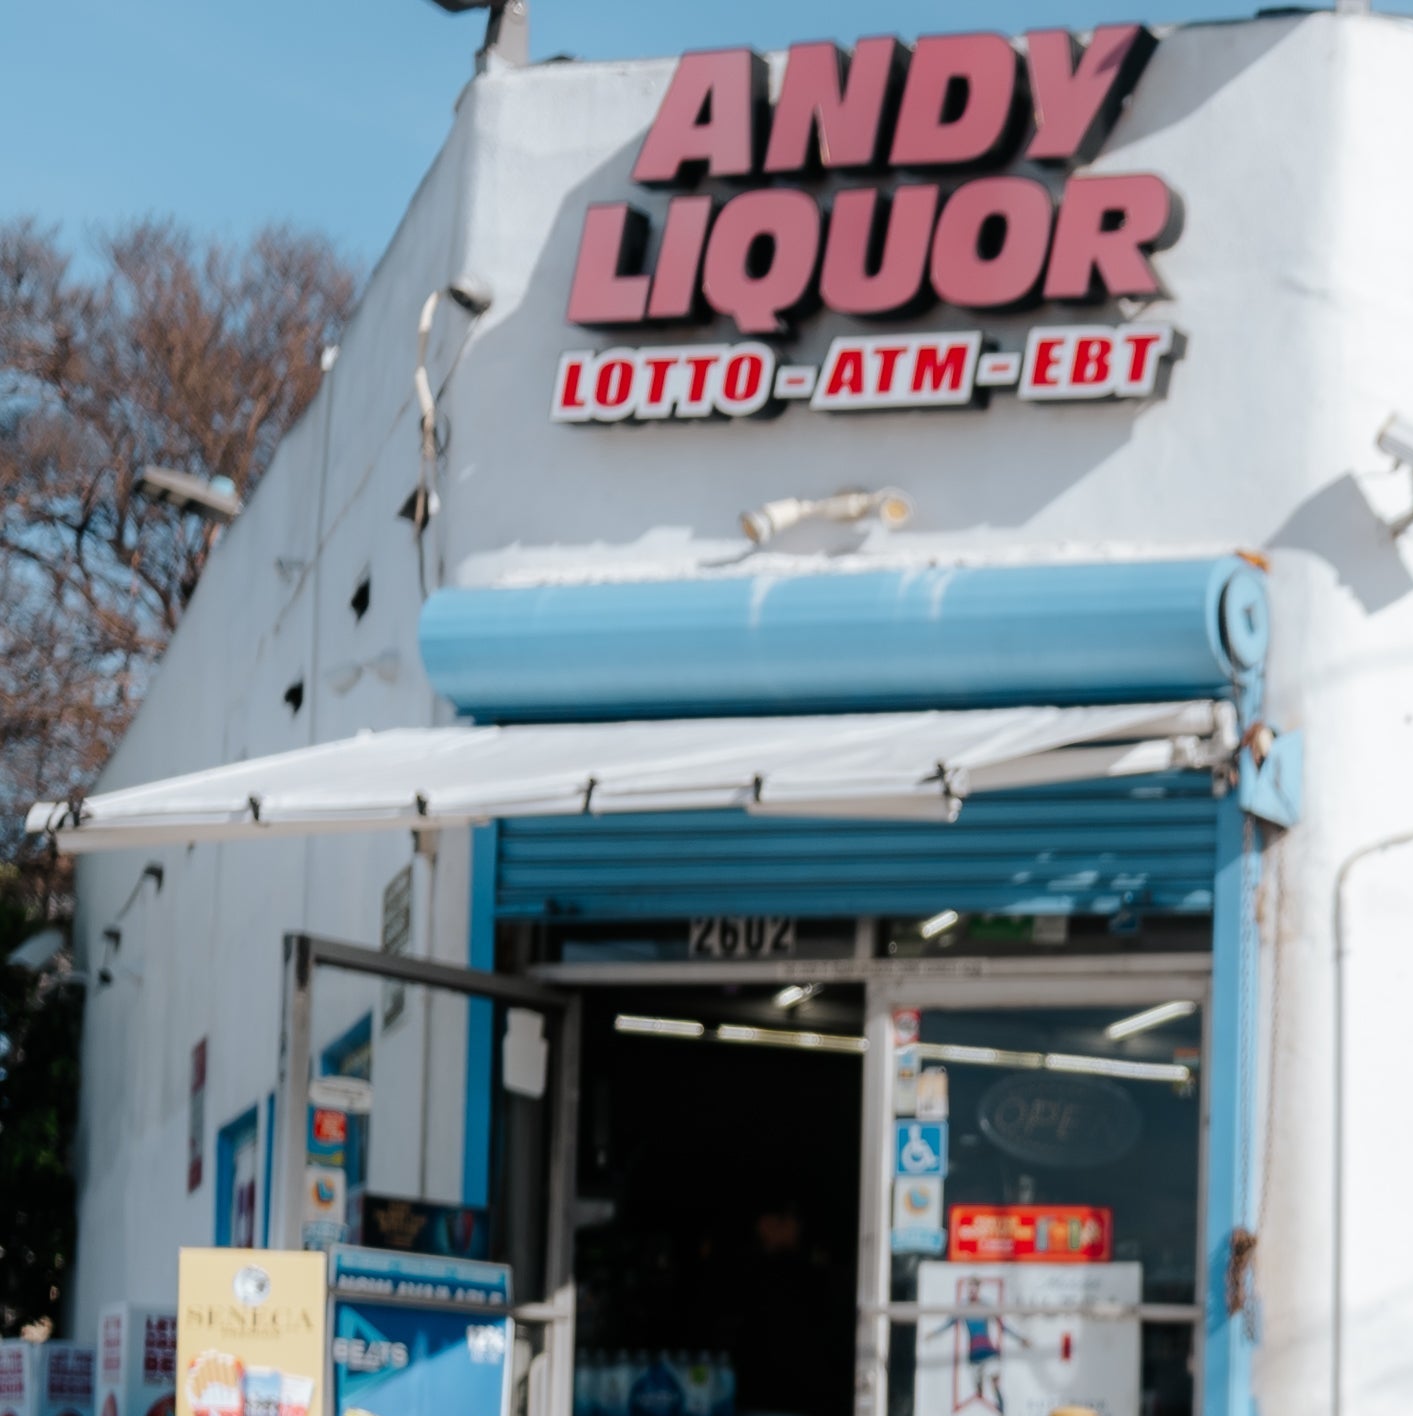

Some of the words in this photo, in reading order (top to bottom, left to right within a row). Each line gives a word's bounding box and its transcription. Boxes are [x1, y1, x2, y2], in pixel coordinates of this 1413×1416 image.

[632, 23, 1146, 184] ANDY
[566, 174, 1172, 333] LIQUOR
[694, 915, 794, 955] 2602
[186, 1305, 314, 1331] SENECA
